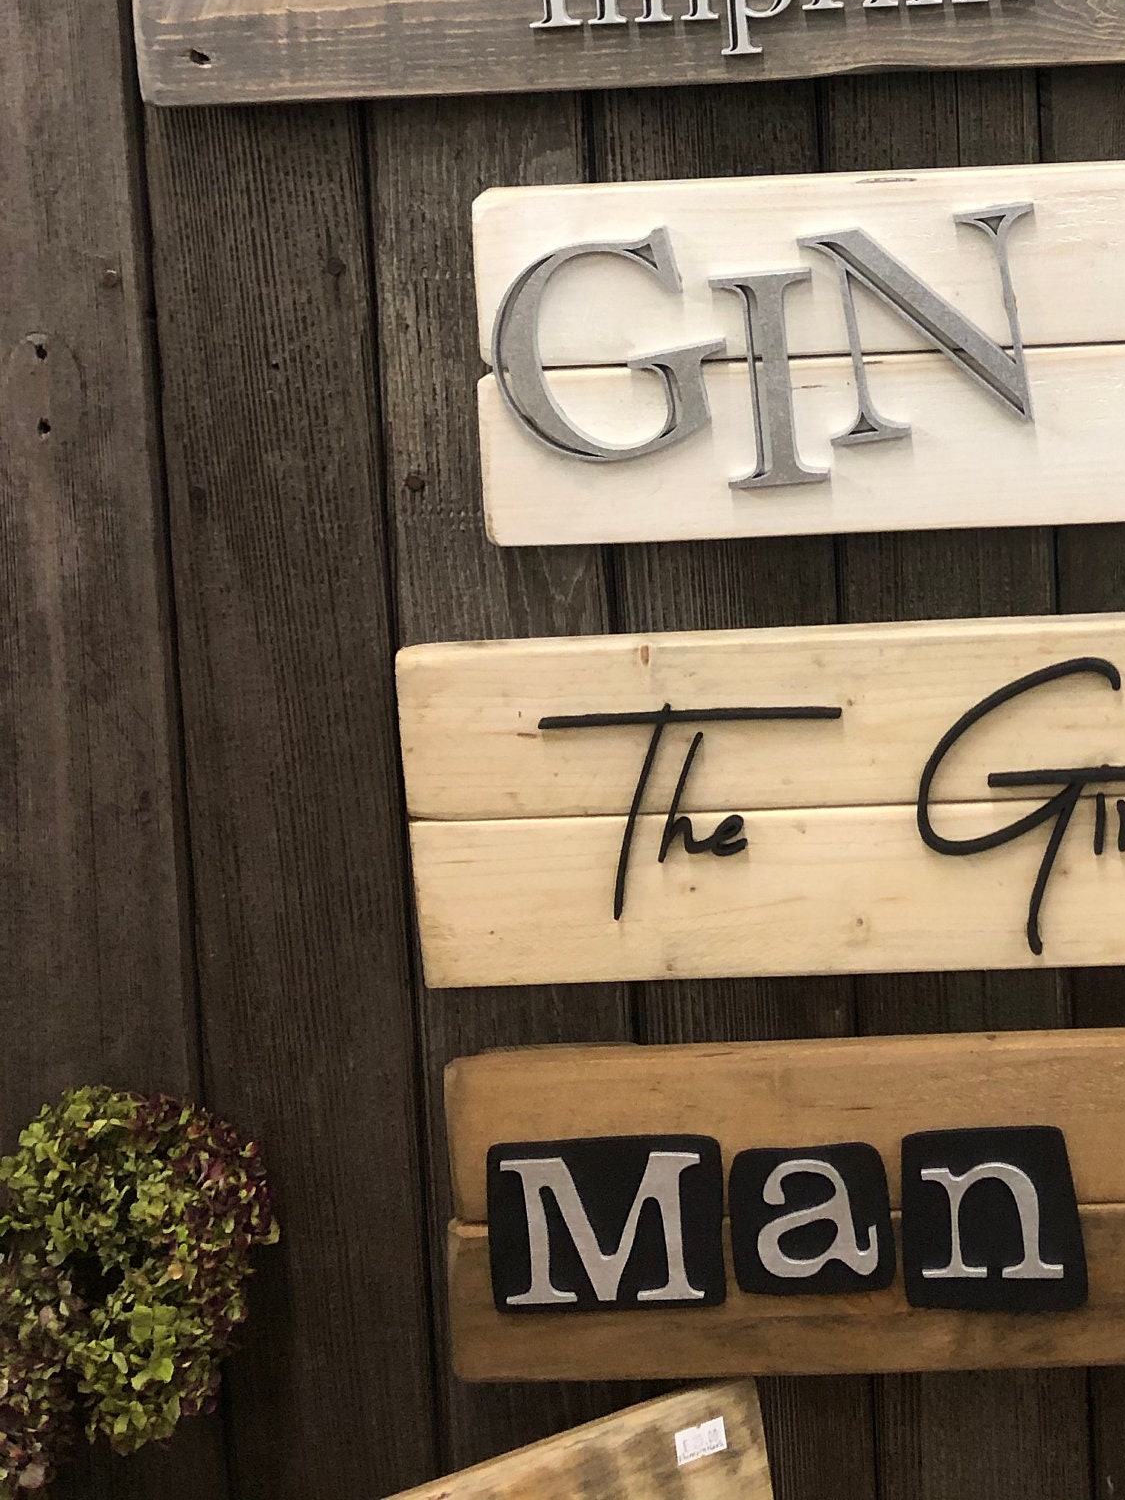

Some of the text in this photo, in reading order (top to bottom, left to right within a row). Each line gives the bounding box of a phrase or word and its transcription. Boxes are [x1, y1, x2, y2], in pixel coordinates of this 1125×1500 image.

[489, 201, 1035, 490] GIN
[538, 704, 842, 921] The
[499, 1150, 1065, 1306] Man
